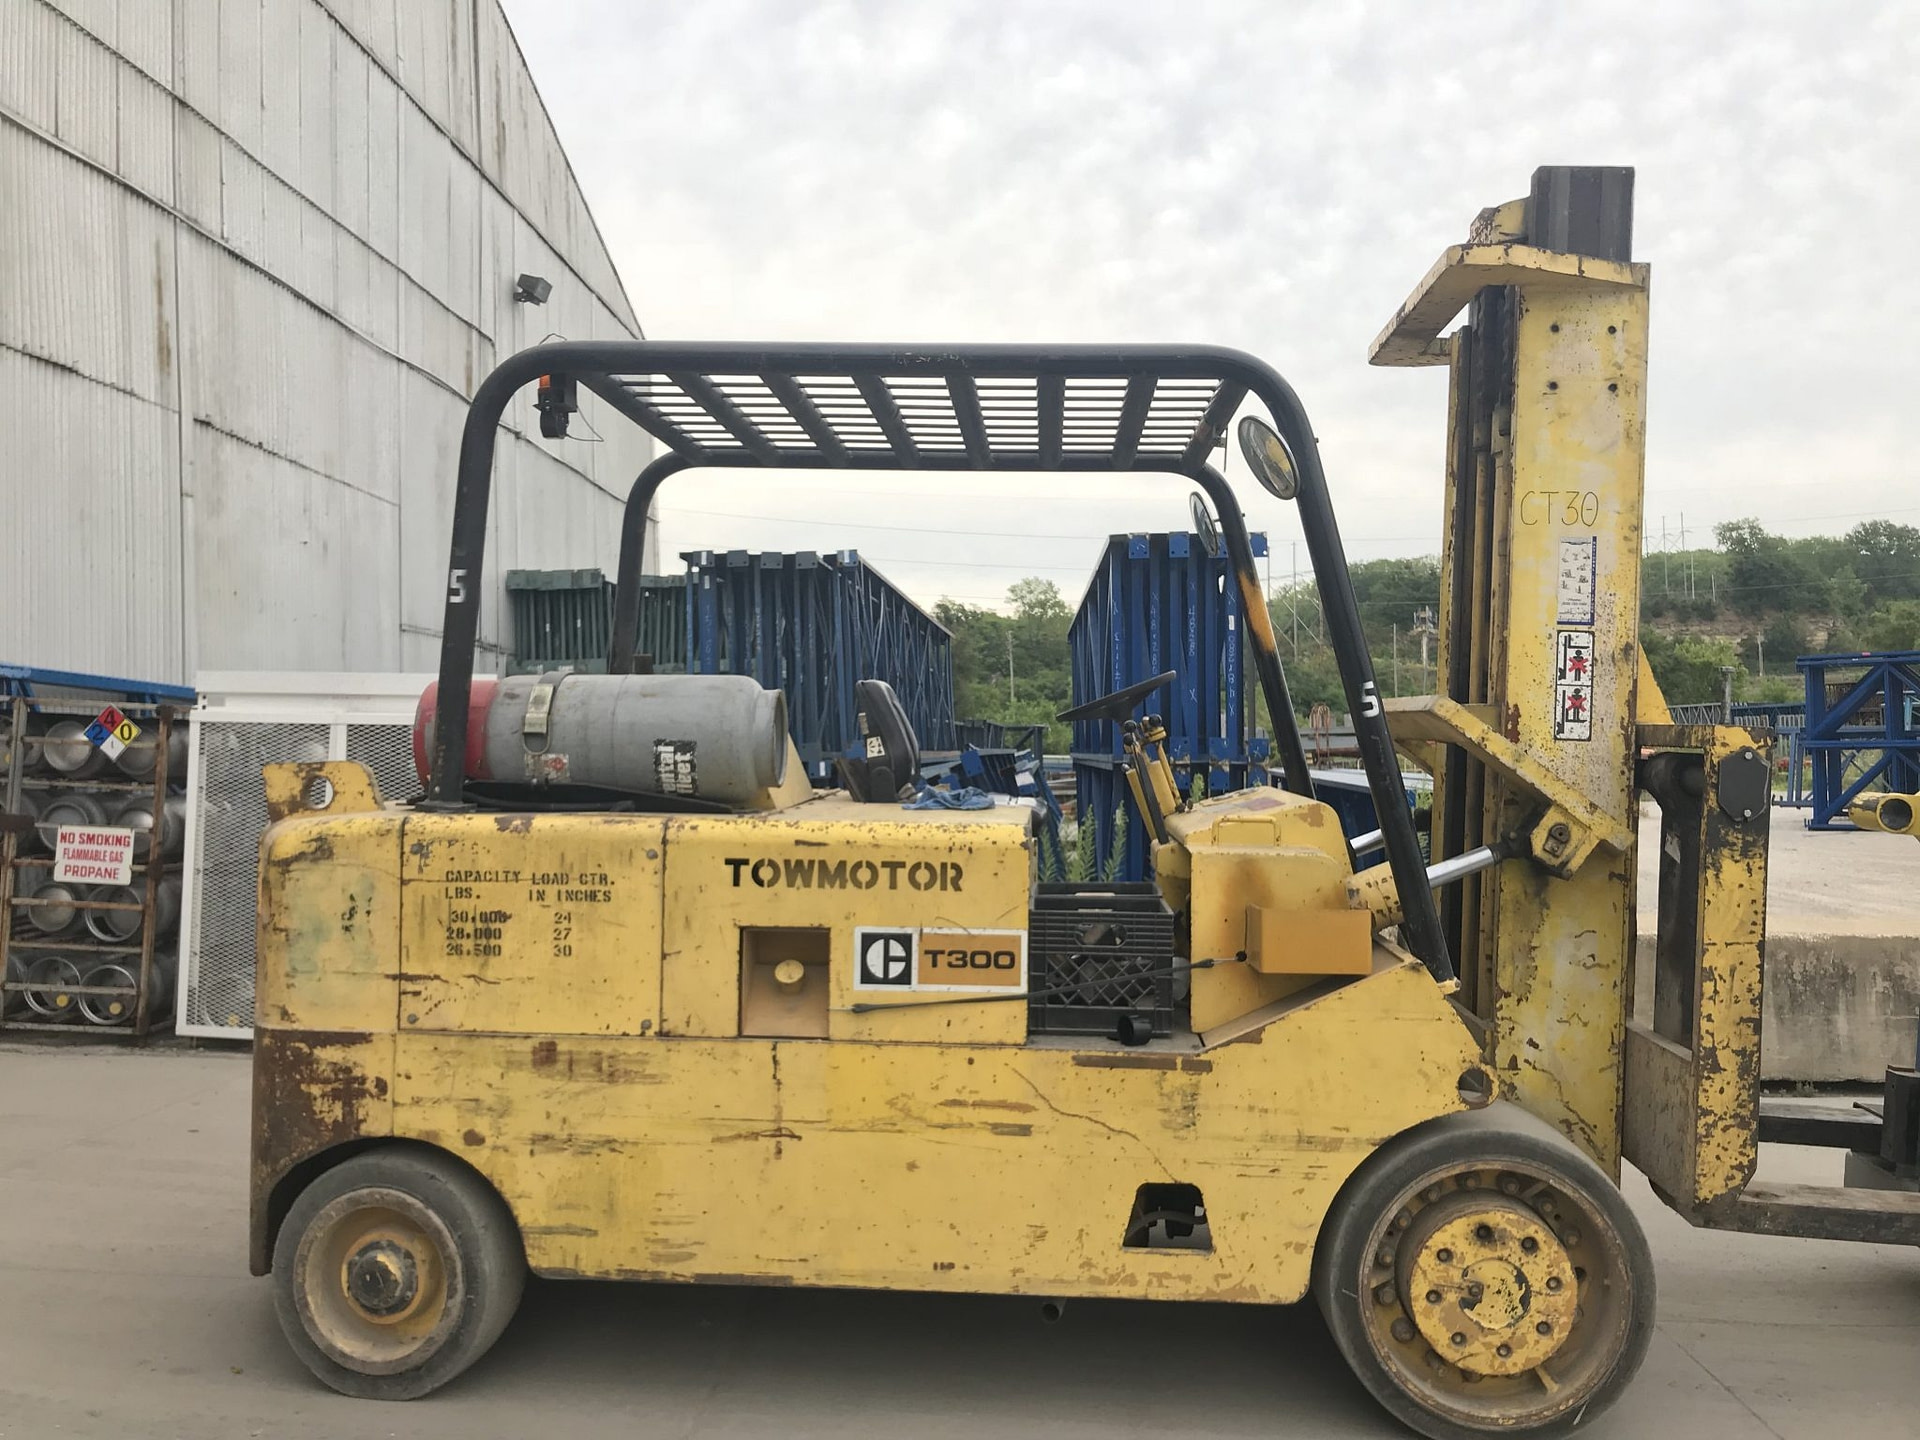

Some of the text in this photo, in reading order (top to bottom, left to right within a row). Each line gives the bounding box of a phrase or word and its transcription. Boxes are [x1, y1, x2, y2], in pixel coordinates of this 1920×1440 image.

[1520, 490, 1599, 527] CT30
[450, 569, 467, 603] 5
[1361, 681, 1380, 718] 5
[103, 709, 117, 728] 4
[91, 723, 106, 741] 2
[120, 723, 133, 741] 0
[657, 745, 677, 793] ental
[60, 832, 131, 847] NO SMOKING
[63, 847, 124, 863] FLAMMABLE GAS
[64, 865, 120, 880] PROPANE
[445, 870, 616, 886] CAPACITY LOAD CTR.
[724, 857, 963, 892] TOWMOTOR
[445, 887, 612, 902] LBS. IN INCHES
[554, 912, 572, 924] 24
[553, 928, 572, 940] 27
[553, 945, 572, 957] 30
[924, 949, 1016, 970] T300
